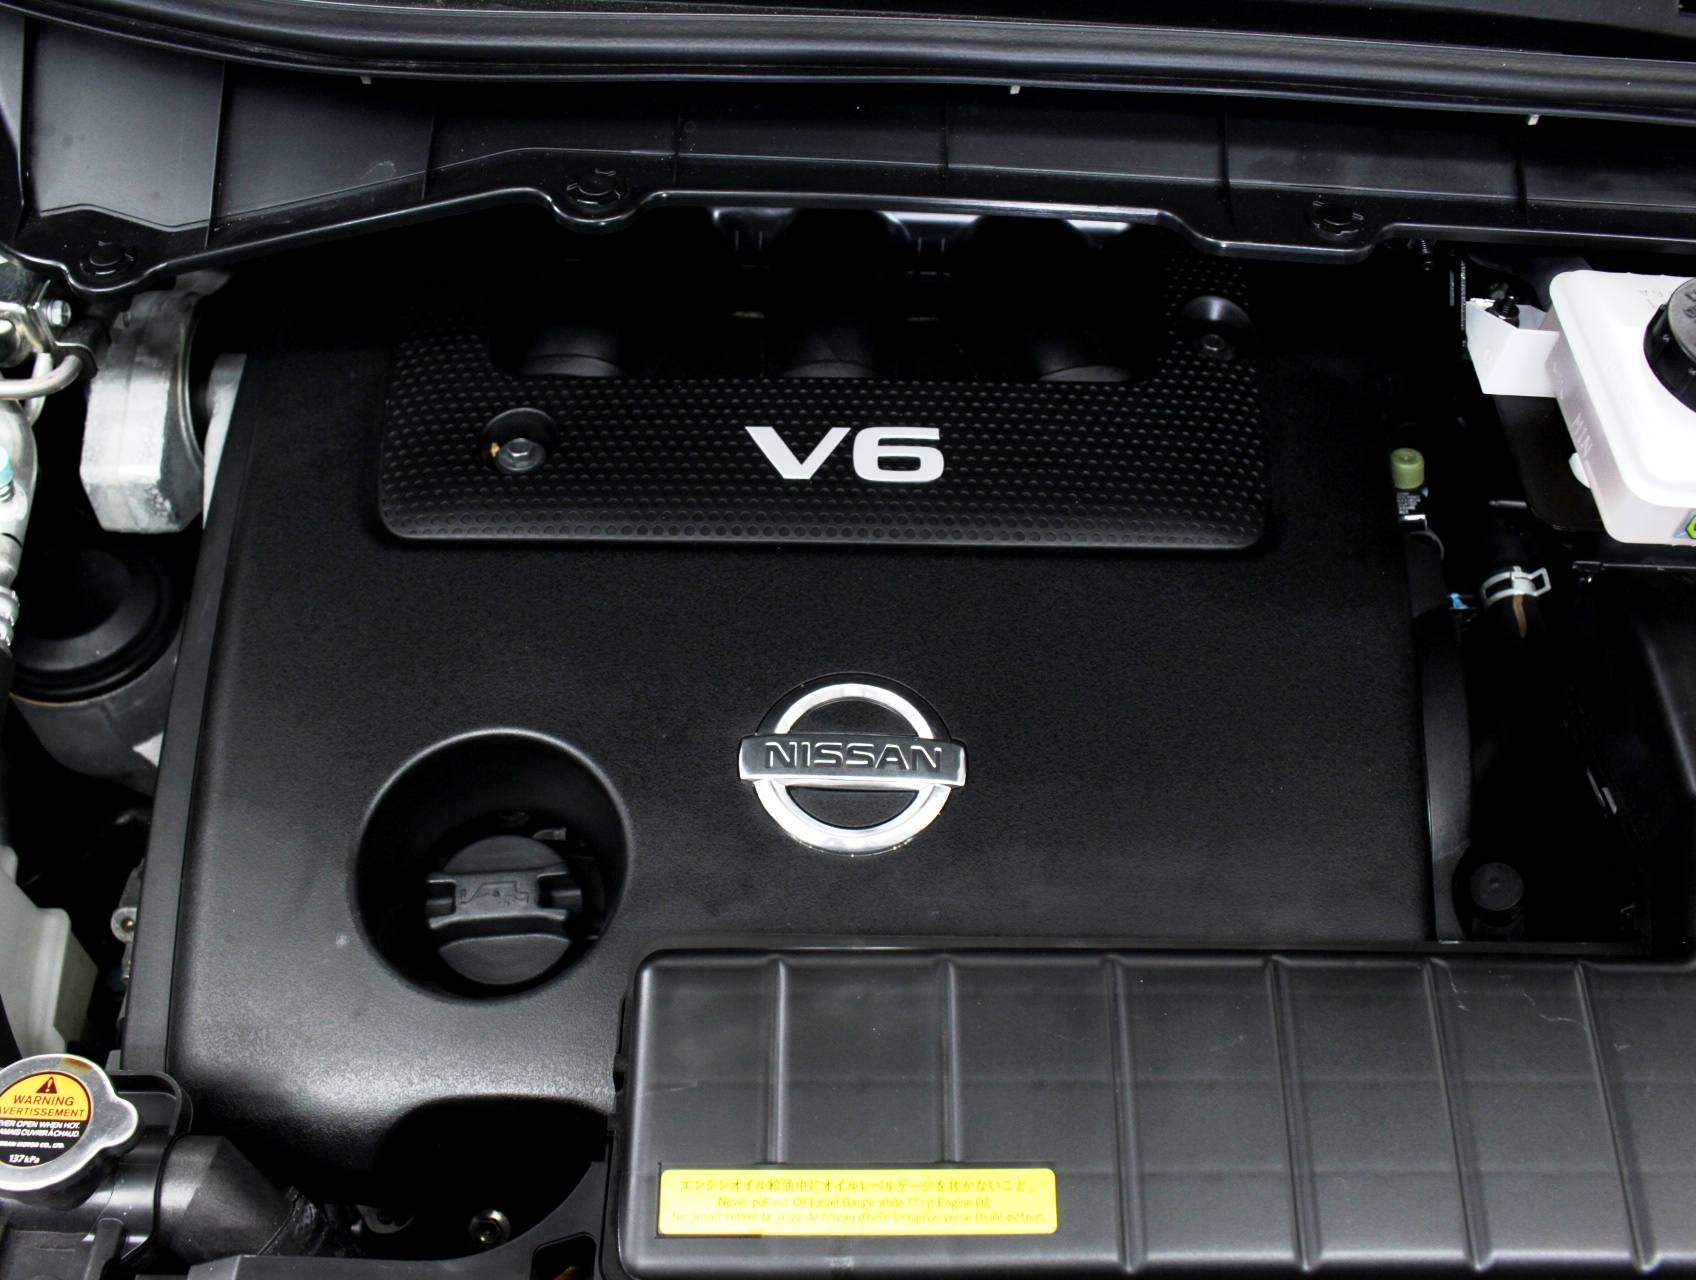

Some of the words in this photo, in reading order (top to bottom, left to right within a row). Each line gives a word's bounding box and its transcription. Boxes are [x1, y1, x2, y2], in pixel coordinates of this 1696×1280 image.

[744, 425, 945, 483] V6
[764, 740, 943, 771] NISSAN
[13, 1095, 75, 1107] WARNING
[16, 1120, 38, 1128] OPEN
[39, 1121, 63, 1129] WHEN
[63, 1121, 80, 1129] HOT.
[9, 1154, 25, 1163] 137
[24, 1155, 40, 1164] kPa
[717, 1196, 748, 1207] Never
[808, 1197, 838, 1207] Level
[937, 1197, 972, 1209] Engine
